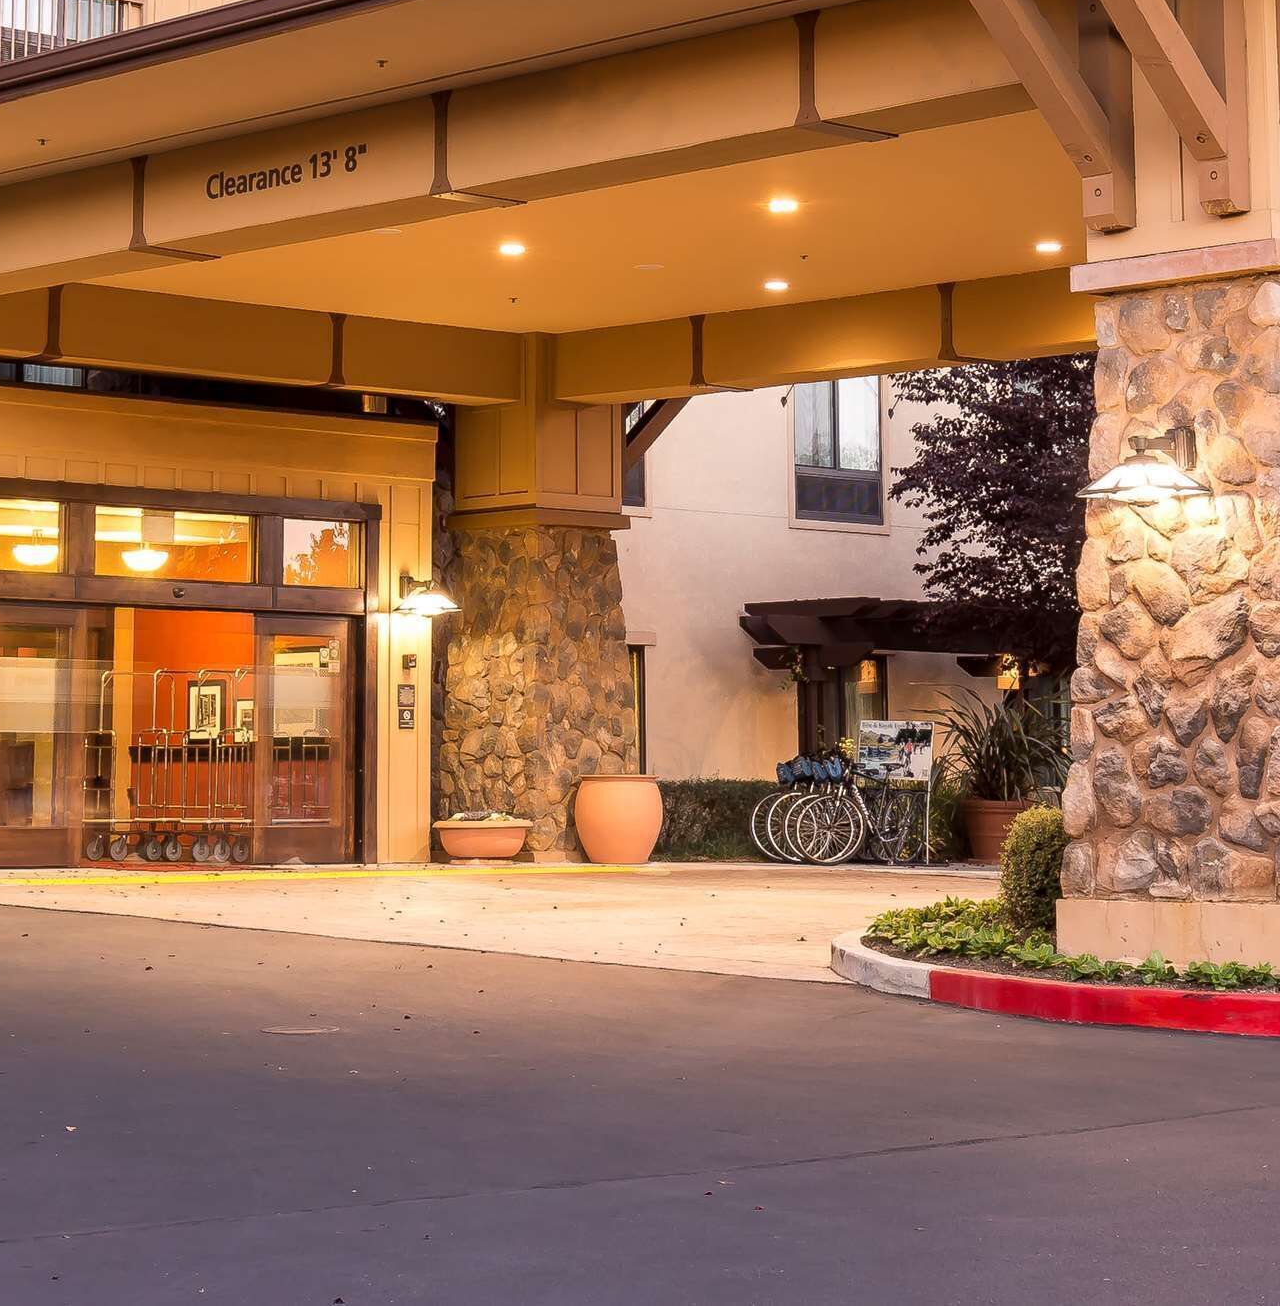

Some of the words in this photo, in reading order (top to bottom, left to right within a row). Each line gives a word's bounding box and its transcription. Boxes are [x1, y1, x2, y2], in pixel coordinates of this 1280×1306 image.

[206, 162, 303, 200] Clearance
[309, 150, 338, 179] 13'
[344, 144, 367, 173] 8"
